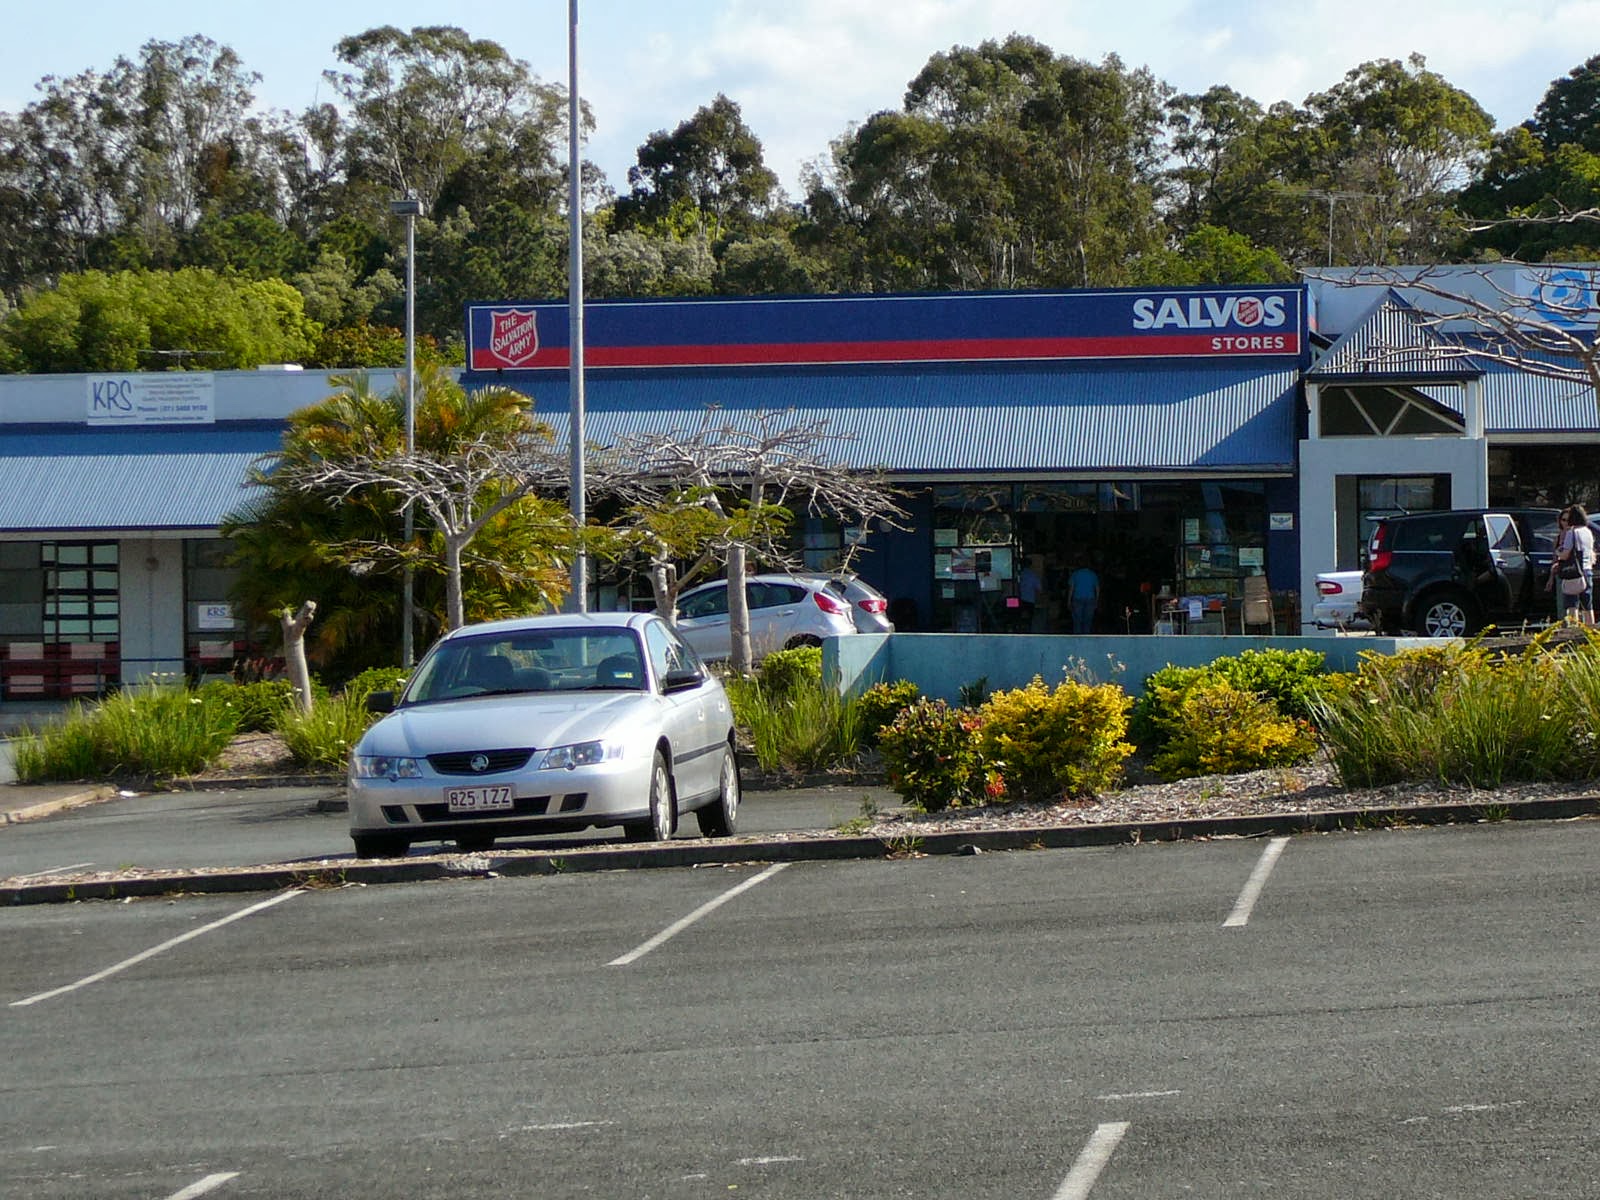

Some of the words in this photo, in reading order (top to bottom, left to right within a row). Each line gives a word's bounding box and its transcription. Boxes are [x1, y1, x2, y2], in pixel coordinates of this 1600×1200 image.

[500, 315, 518, 333] THE
[1132, 296, 1286, 329] SALVOS
[494, 316, 533, 352] SALVATION
[508, 332, 532, 358] ARMY
[1212, 336, 1285, 350] STORES
[92, 380, 132, 411] KRS
[450, 791, 476, 807] 825
